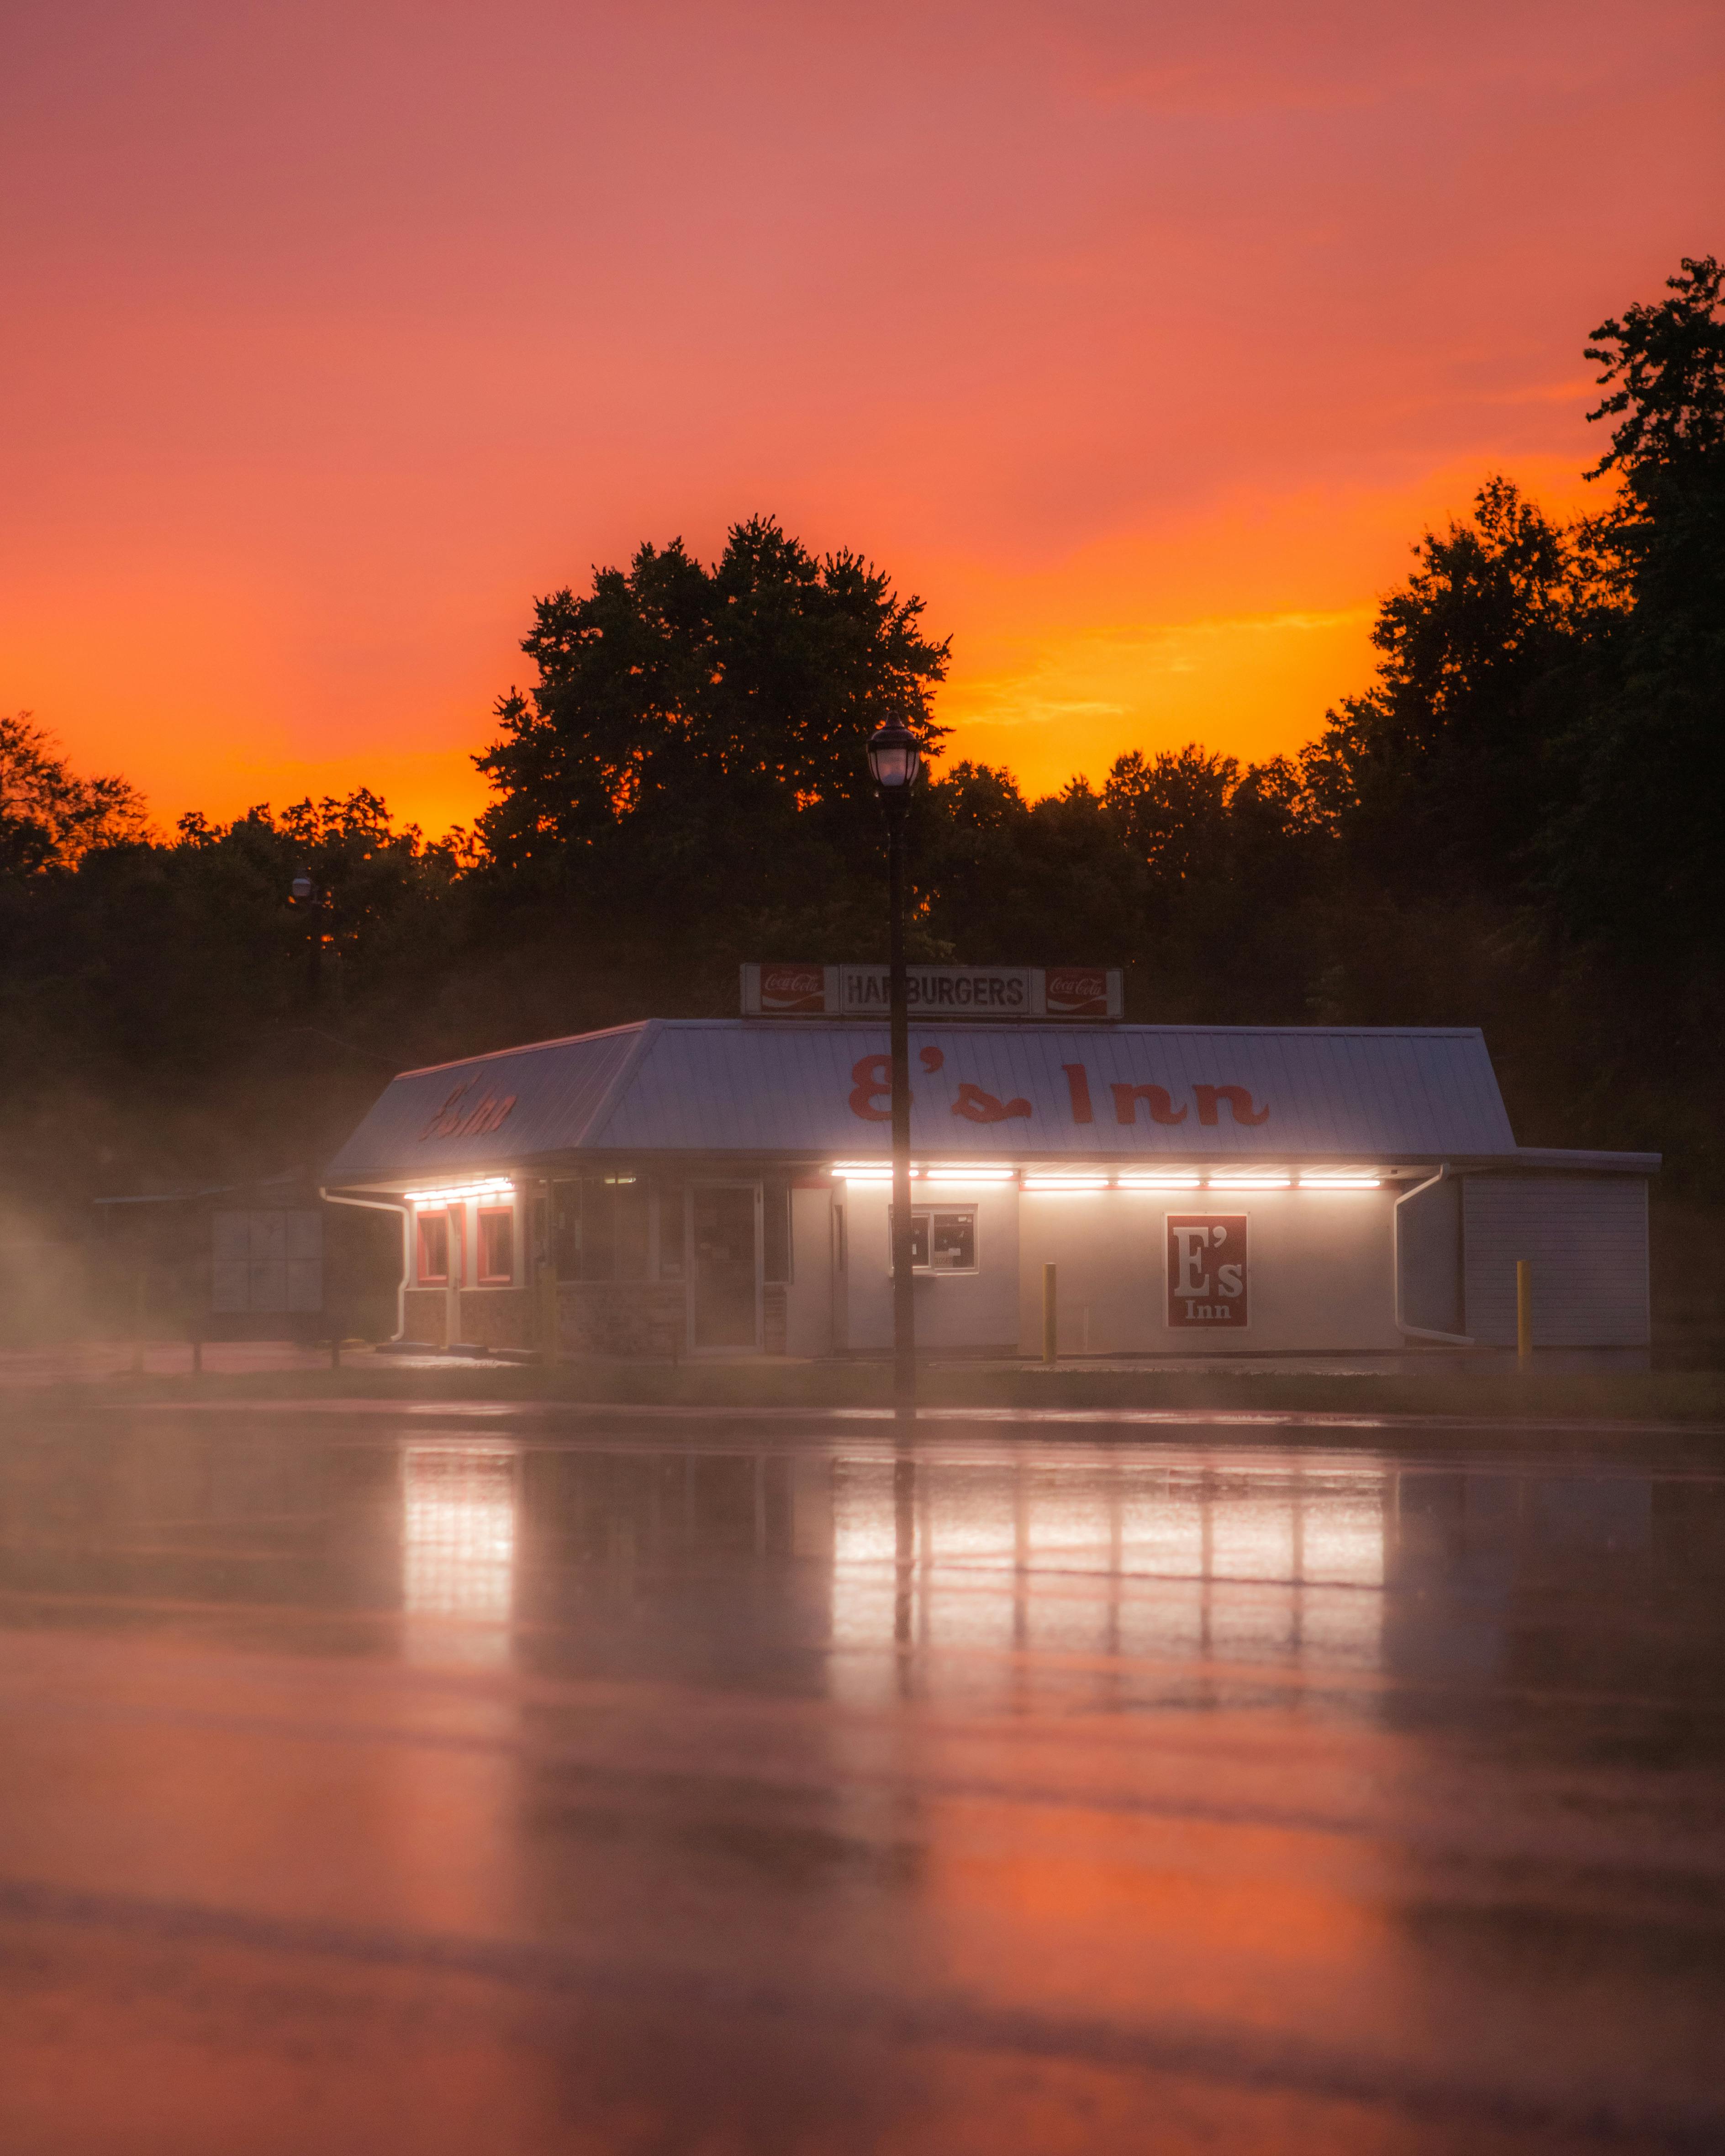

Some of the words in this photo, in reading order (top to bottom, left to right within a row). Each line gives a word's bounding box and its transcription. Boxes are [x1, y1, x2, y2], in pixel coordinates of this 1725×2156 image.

[1063, 1064, 1270, 1126] Inn
[1173, 1226, 1243, 1297] E's
[1186, 1300, 1231, 1319] Inn
